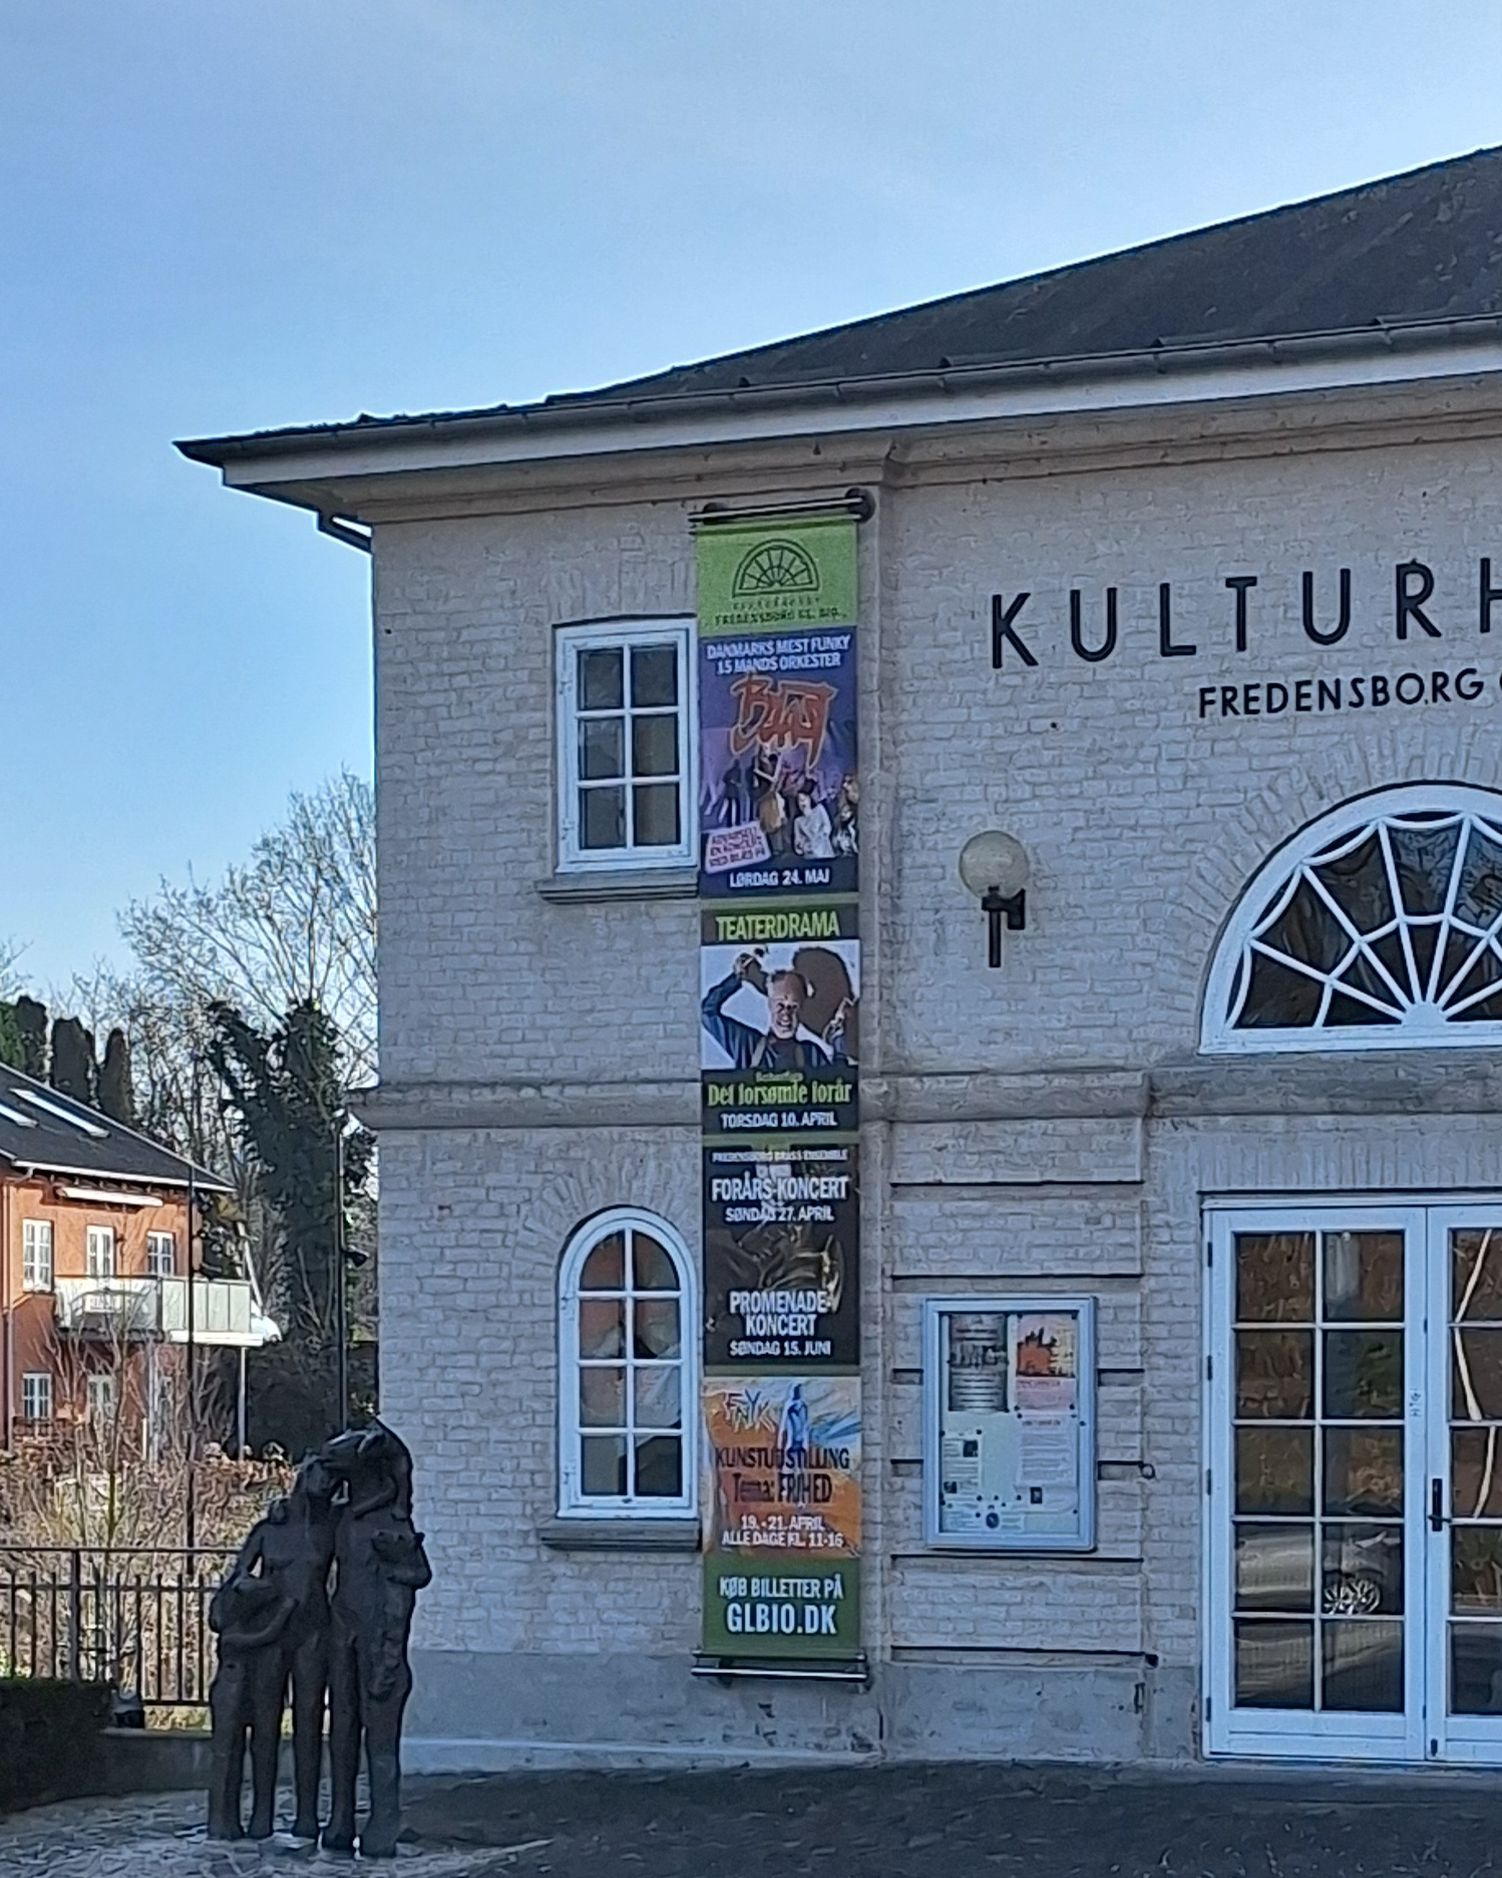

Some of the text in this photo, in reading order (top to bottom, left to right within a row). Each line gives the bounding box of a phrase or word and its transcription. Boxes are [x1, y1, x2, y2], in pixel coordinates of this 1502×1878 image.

[706, 634, 851, 660] DANMARKS MEST FUNKY
[717, 652, 841, 675] 15 MANDS ORKESTER
[1199, 668, 1484, 718] FREDENSBORG
[729, 867, 830, 888] LØRDAG 24. MAJ
[715, 911, 840, 941] TEATERDRAMA
[707, 1076, 852, 1107] Det forsømte forår
[720, 1110, 838, 1129] TORSDAG 10. APRIL
[711, 1170, 849, 1202] FORÅRS-KONCERT
[724, 1204, 836, 1222] SØNDAG 27. APRIL
[745, 1313, 818, 1337] KONCERT
[729, 1340, 832, 1356] SØNDAG 15. JUNI
[777, 1472, 833, 1503] FRIHED
[789, 1515, 826, 1532] APRIL
[721, 1530, 750, 1546] ALLE
[752, 1531, 786, 1547] DAGE
[719, 1572, 845, 1600] KØB BILLETTER PÅ
[726, 1602, 837, 1635] GLBIO.DK
